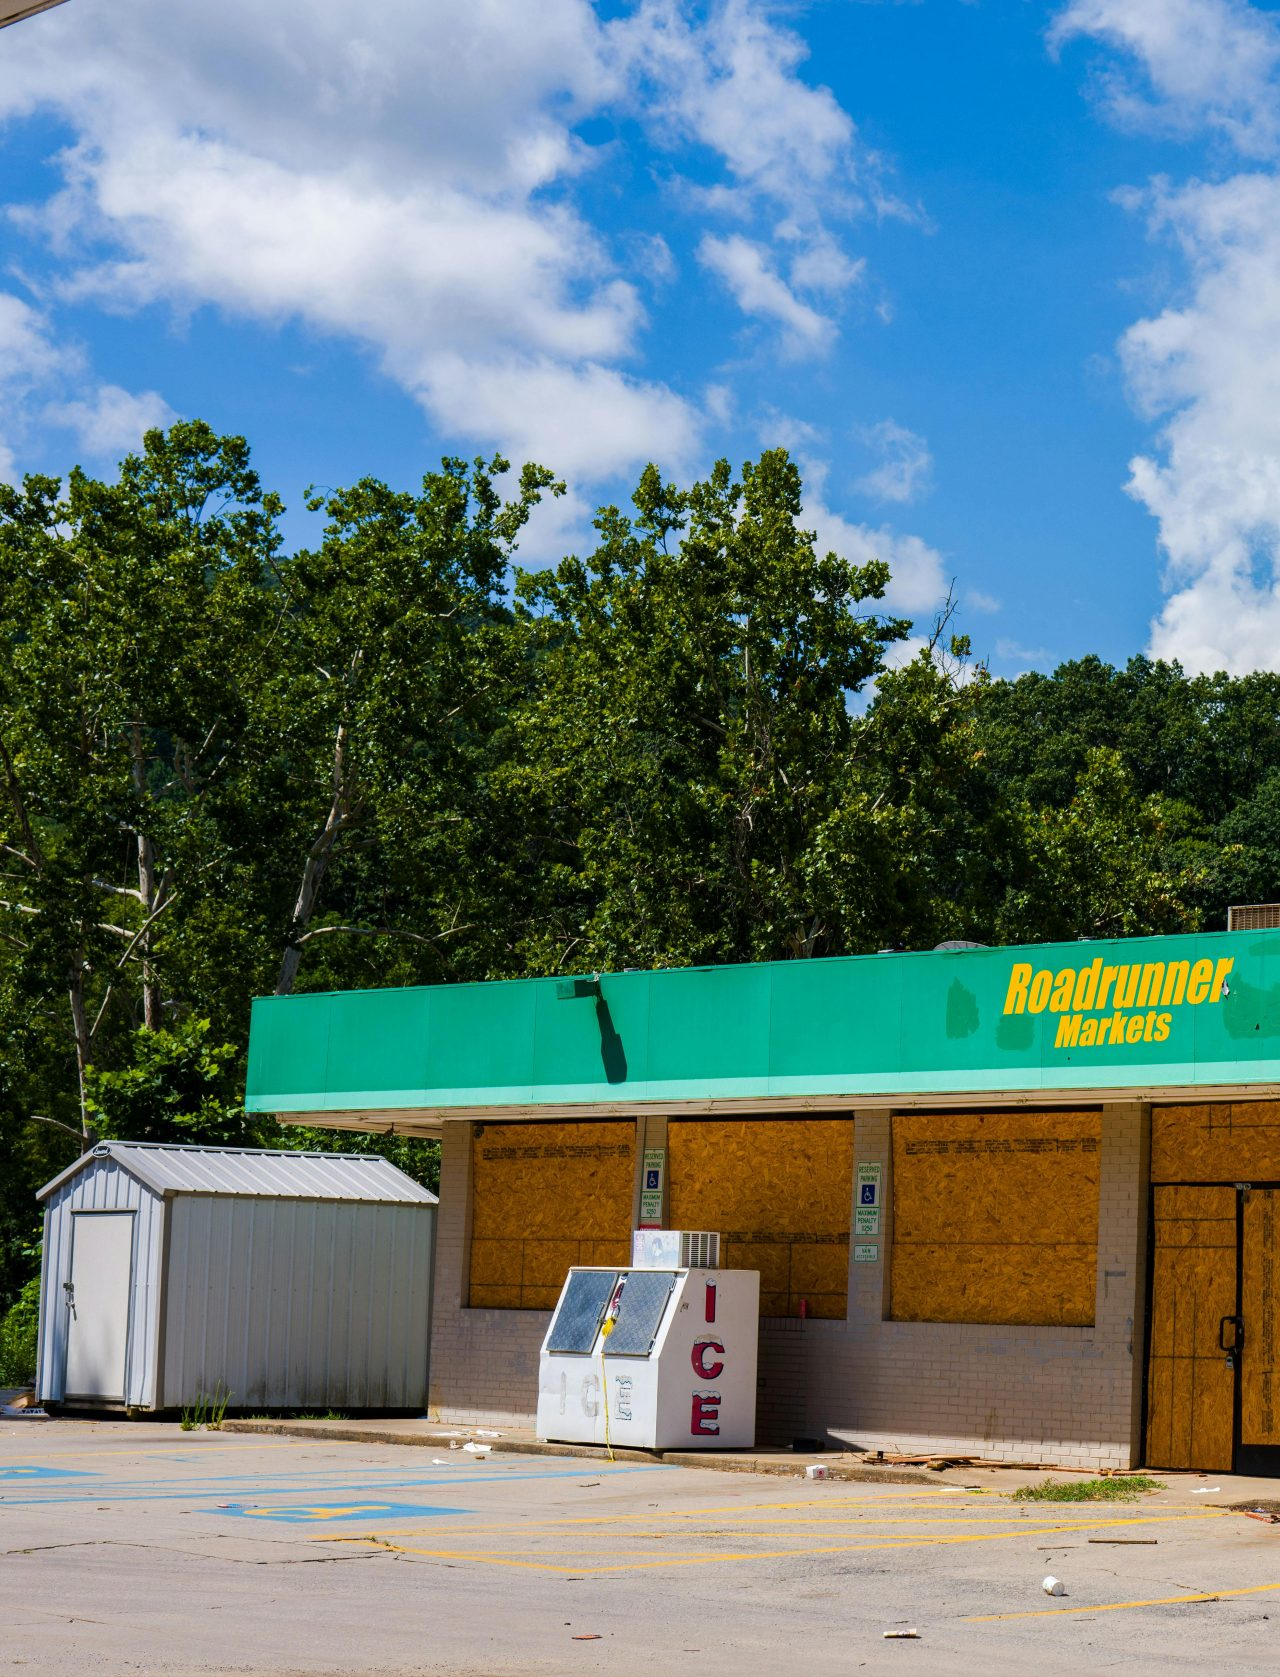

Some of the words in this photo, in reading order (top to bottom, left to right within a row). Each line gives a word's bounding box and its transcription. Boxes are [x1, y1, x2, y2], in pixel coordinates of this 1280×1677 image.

[1003, 957, 1234, 1015] Roadrunner
[1054, 1010, 1171, 1048] Markets
[858, 1165, 880, 1174] RESERVED
[690, 1277, 726, 1436] ICE
